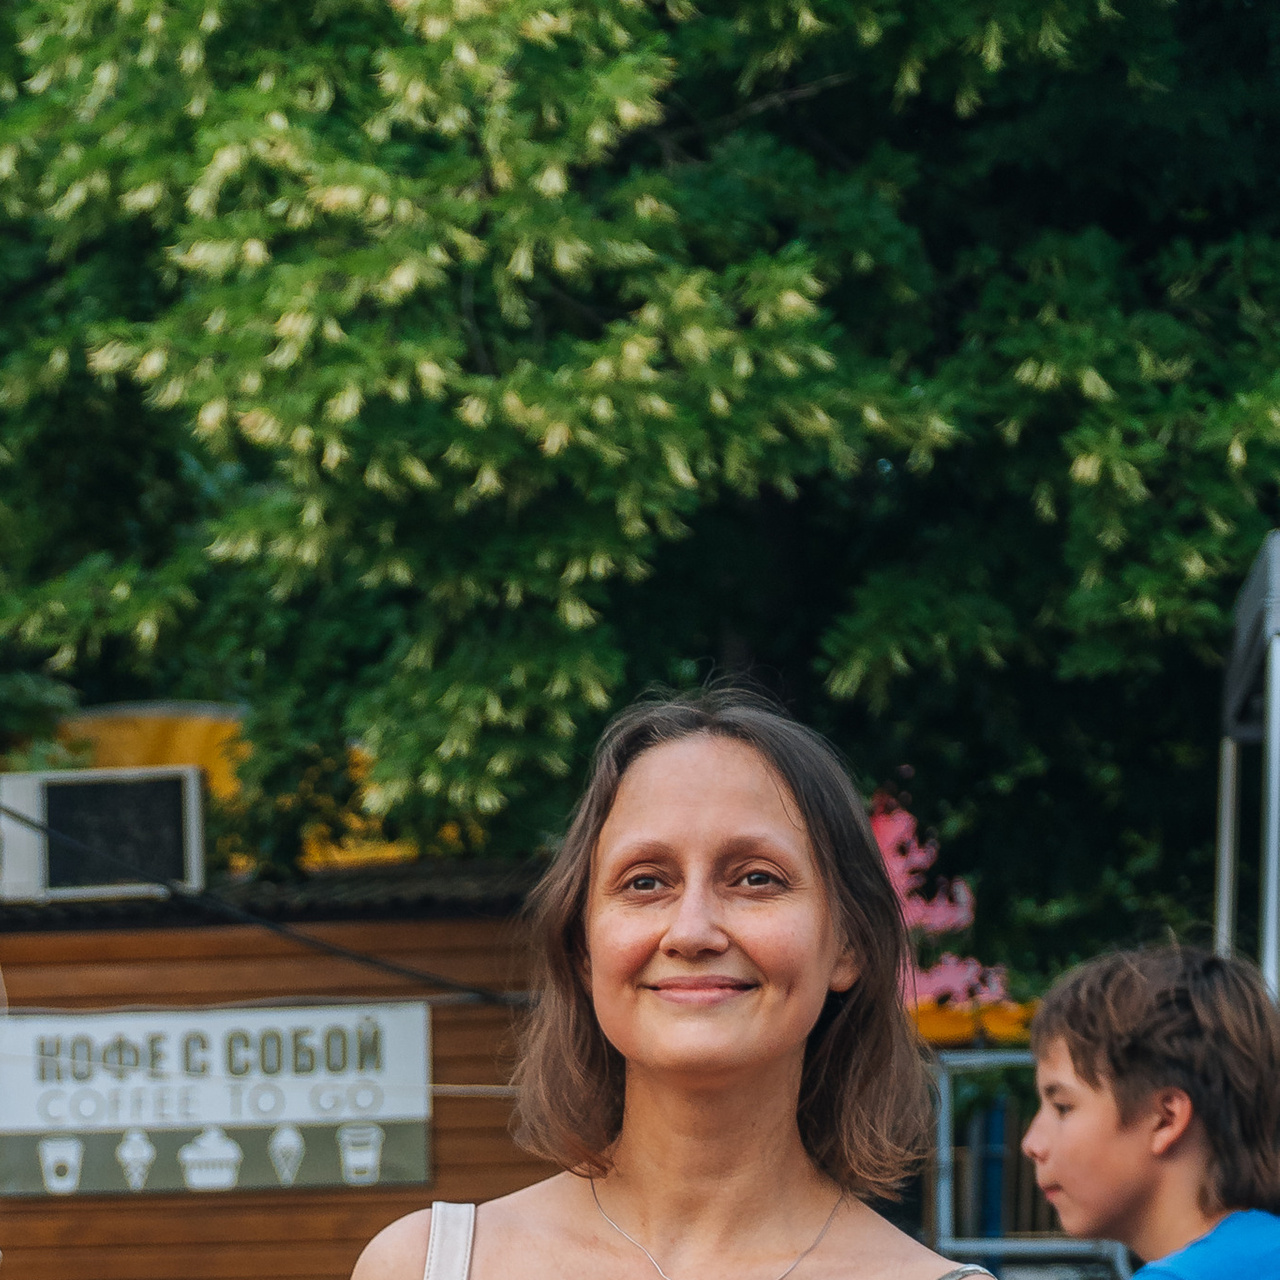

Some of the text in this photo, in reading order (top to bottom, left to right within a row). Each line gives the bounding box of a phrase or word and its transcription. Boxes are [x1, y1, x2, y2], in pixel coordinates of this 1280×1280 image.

[36, 1015, 385, 1083] КОФЕ С СОБОЙ
[36, 1079, 385, 1124] COFFEE TO GO
